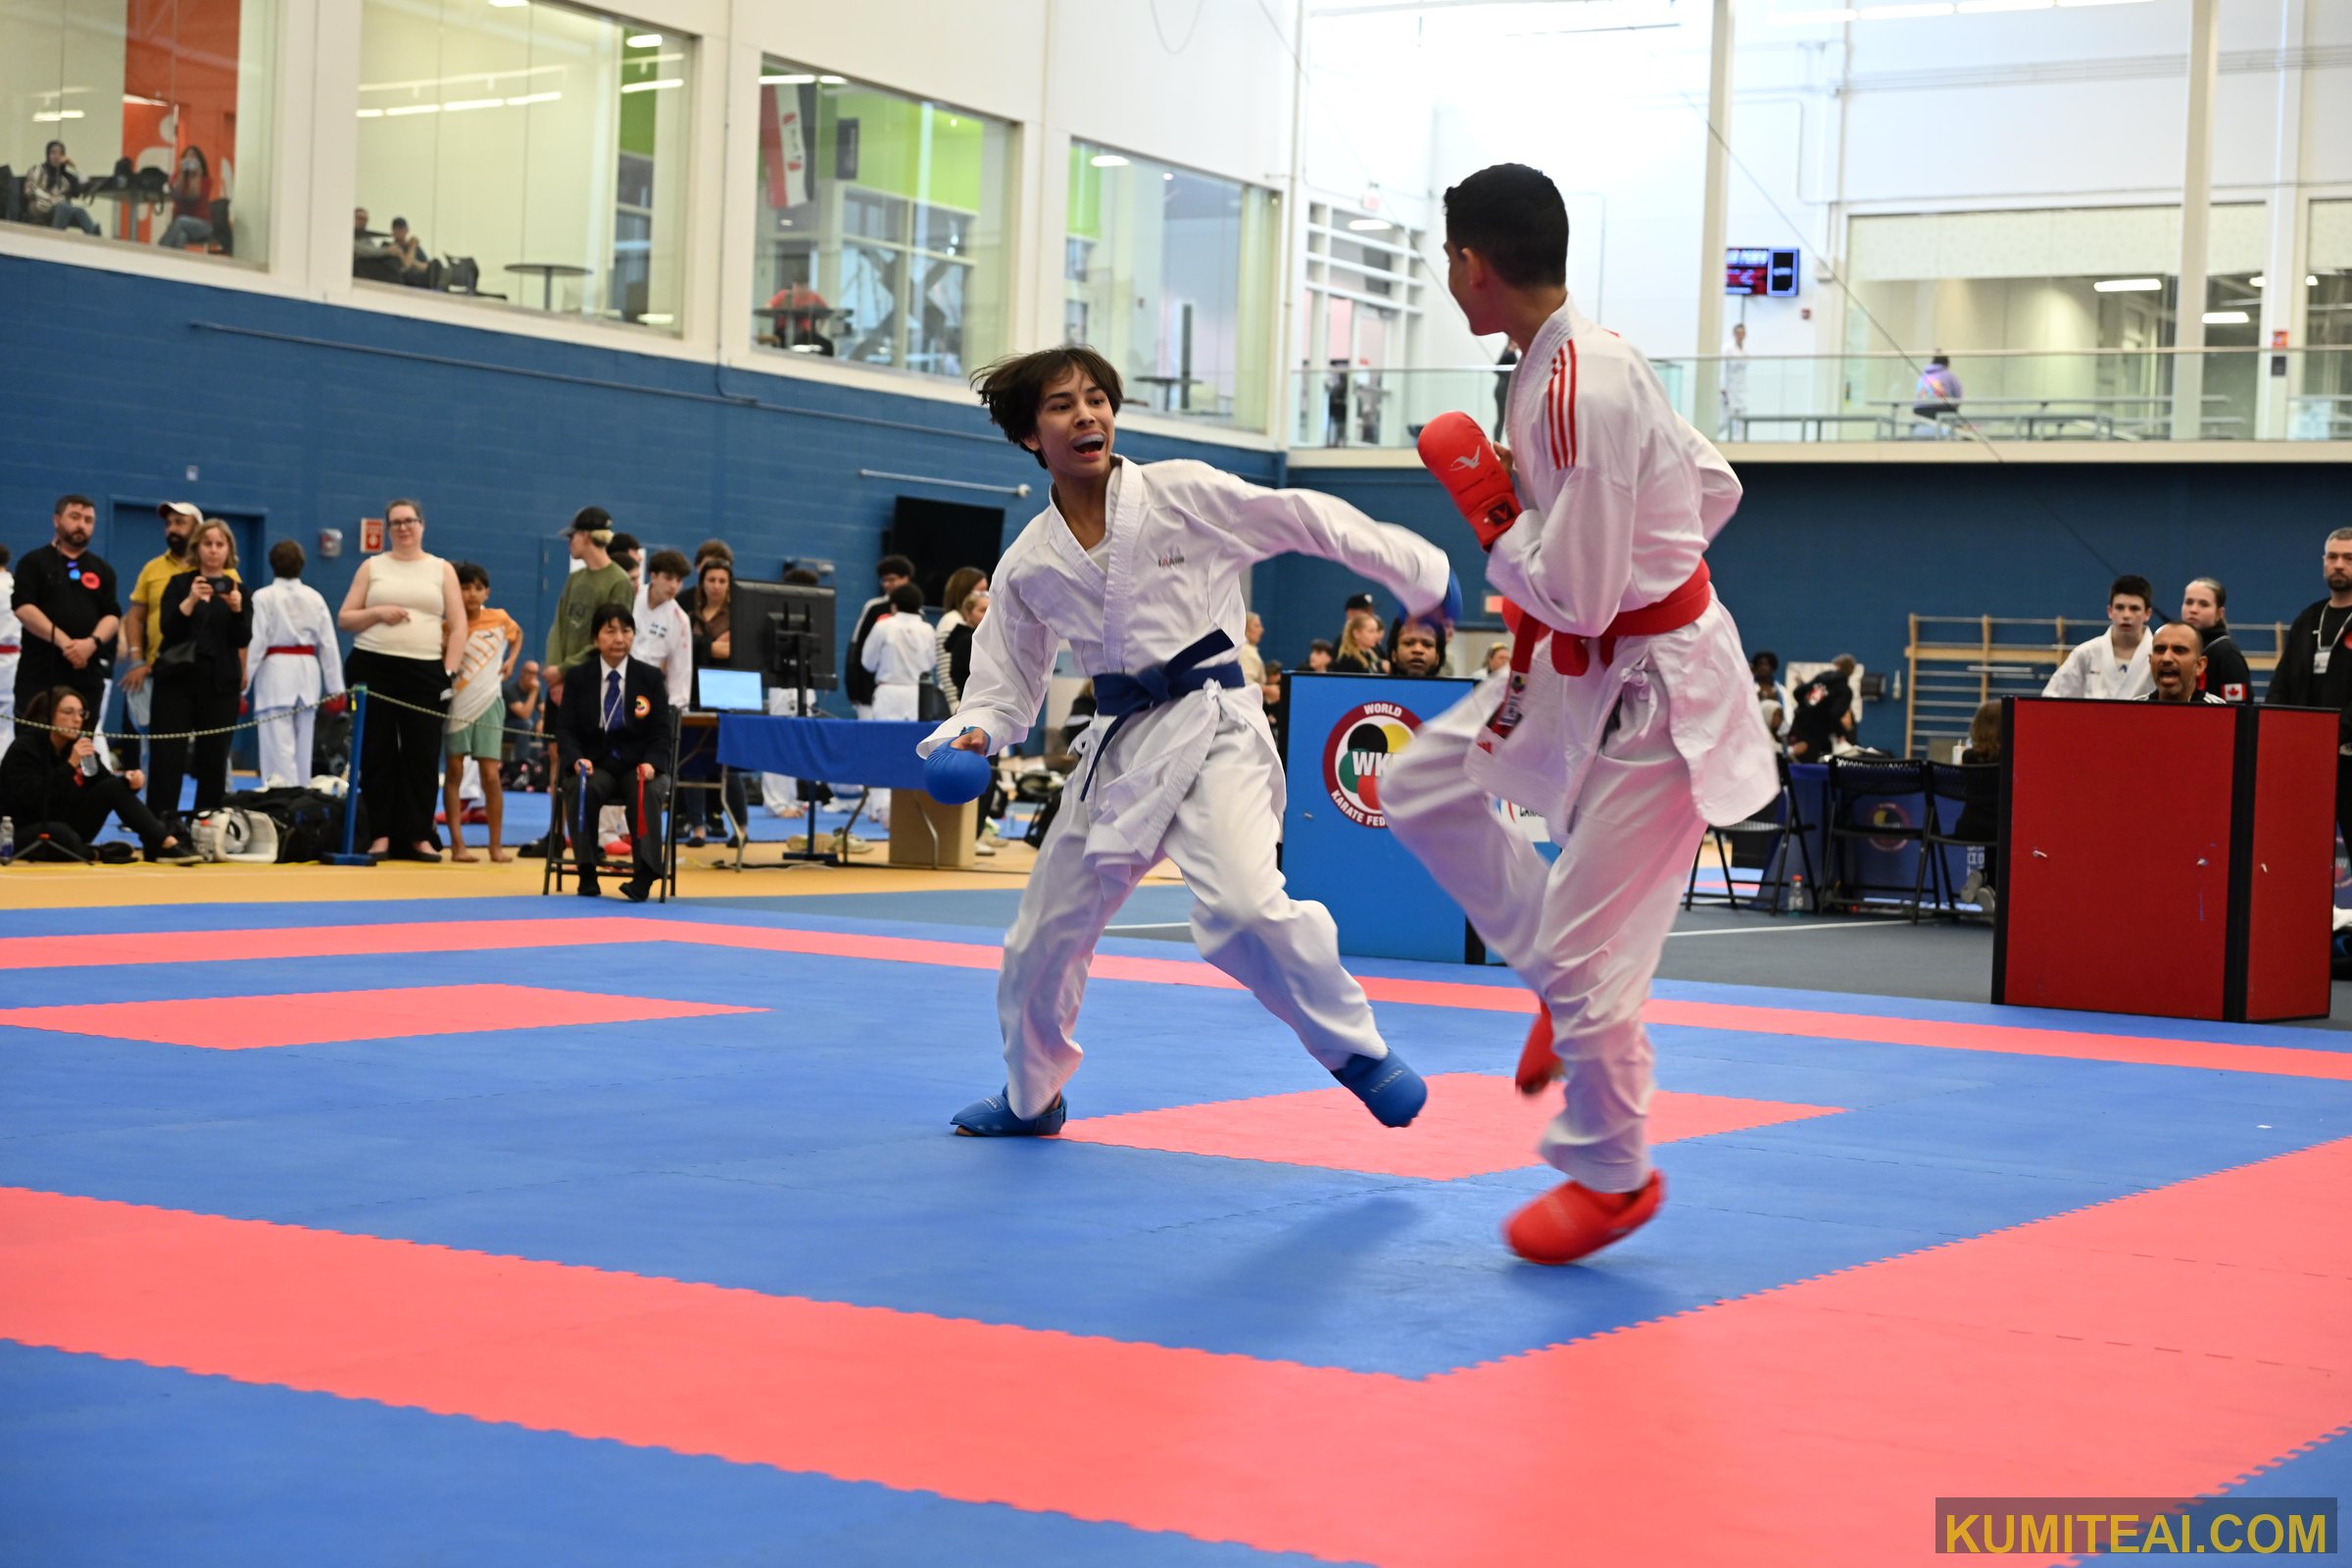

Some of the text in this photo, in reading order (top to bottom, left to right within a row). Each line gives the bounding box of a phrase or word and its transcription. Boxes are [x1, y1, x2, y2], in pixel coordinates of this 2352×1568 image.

[1363, 704, 1402, 717] WORLD
[1351, 751, 1393, 777] WK
[1331, 789, 1389, 826] KARATE FED
